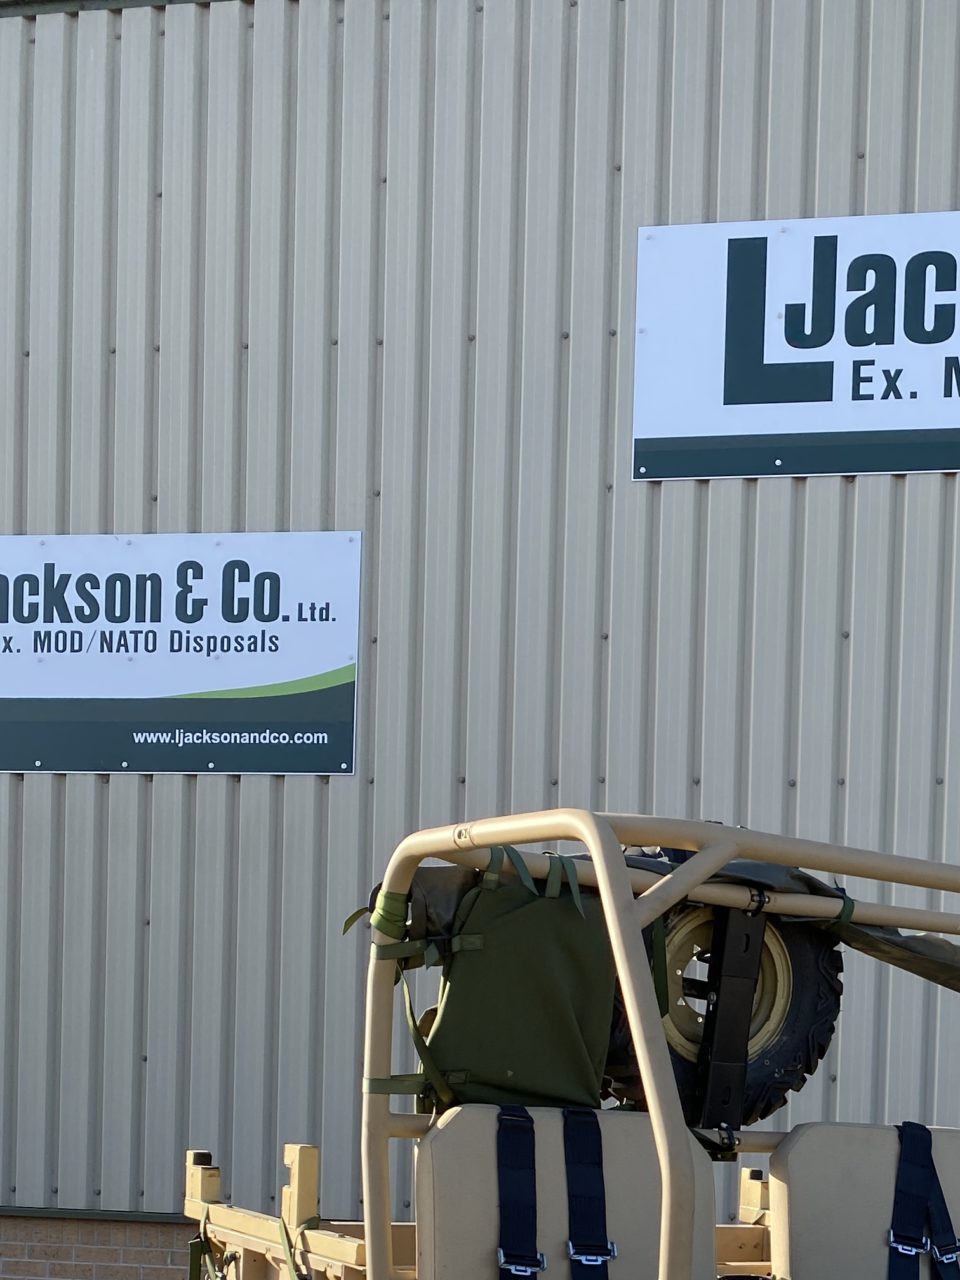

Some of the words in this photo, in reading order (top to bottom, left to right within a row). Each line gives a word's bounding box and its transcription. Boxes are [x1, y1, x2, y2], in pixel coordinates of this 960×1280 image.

[852, 359, 918, 401] Ex.
[175, 560, 209, 624] &
[221, 559, 290, 624] Co.
[297, 602, 337, 622] Ltd.
[33, 629, 157, 654] MOD/NATO
[169, 629, 280, 657] Disposals
[133, 729, 328, 746] www.ljacksonandco.com
